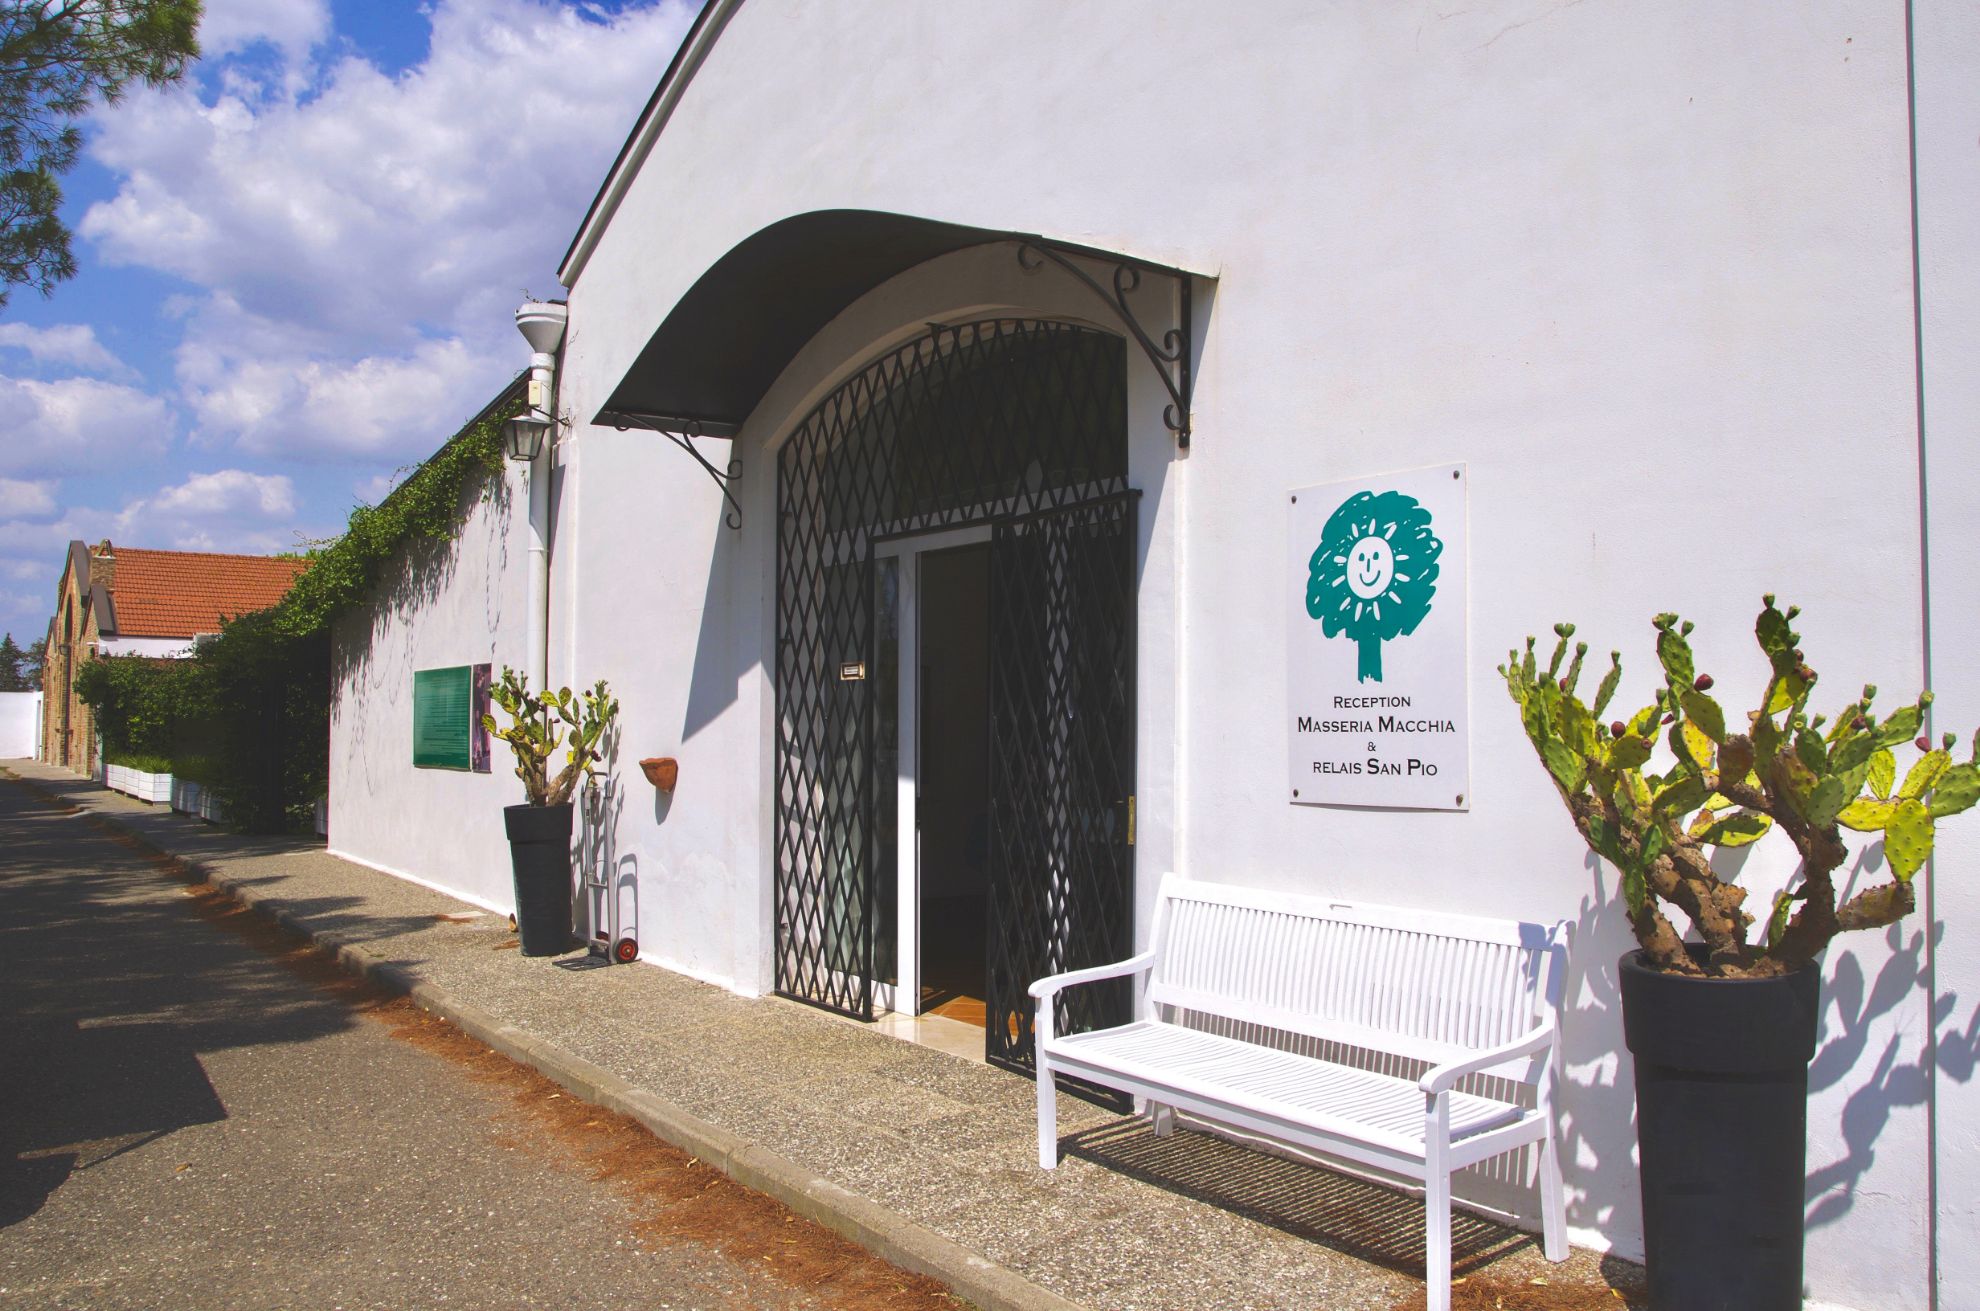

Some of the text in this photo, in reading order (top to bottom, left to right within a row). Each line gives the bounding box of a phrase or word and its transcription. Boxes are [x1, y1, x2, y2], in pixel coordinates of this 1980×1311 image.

[1334, 696, 1411, 709] RECEPTION
[1298, 715, 1456, 733] MASSERIA MACCHIA
[1367, 741, 1377, 752] &
[1313, 757, 1438, 777] RELAIS SAN PIO
